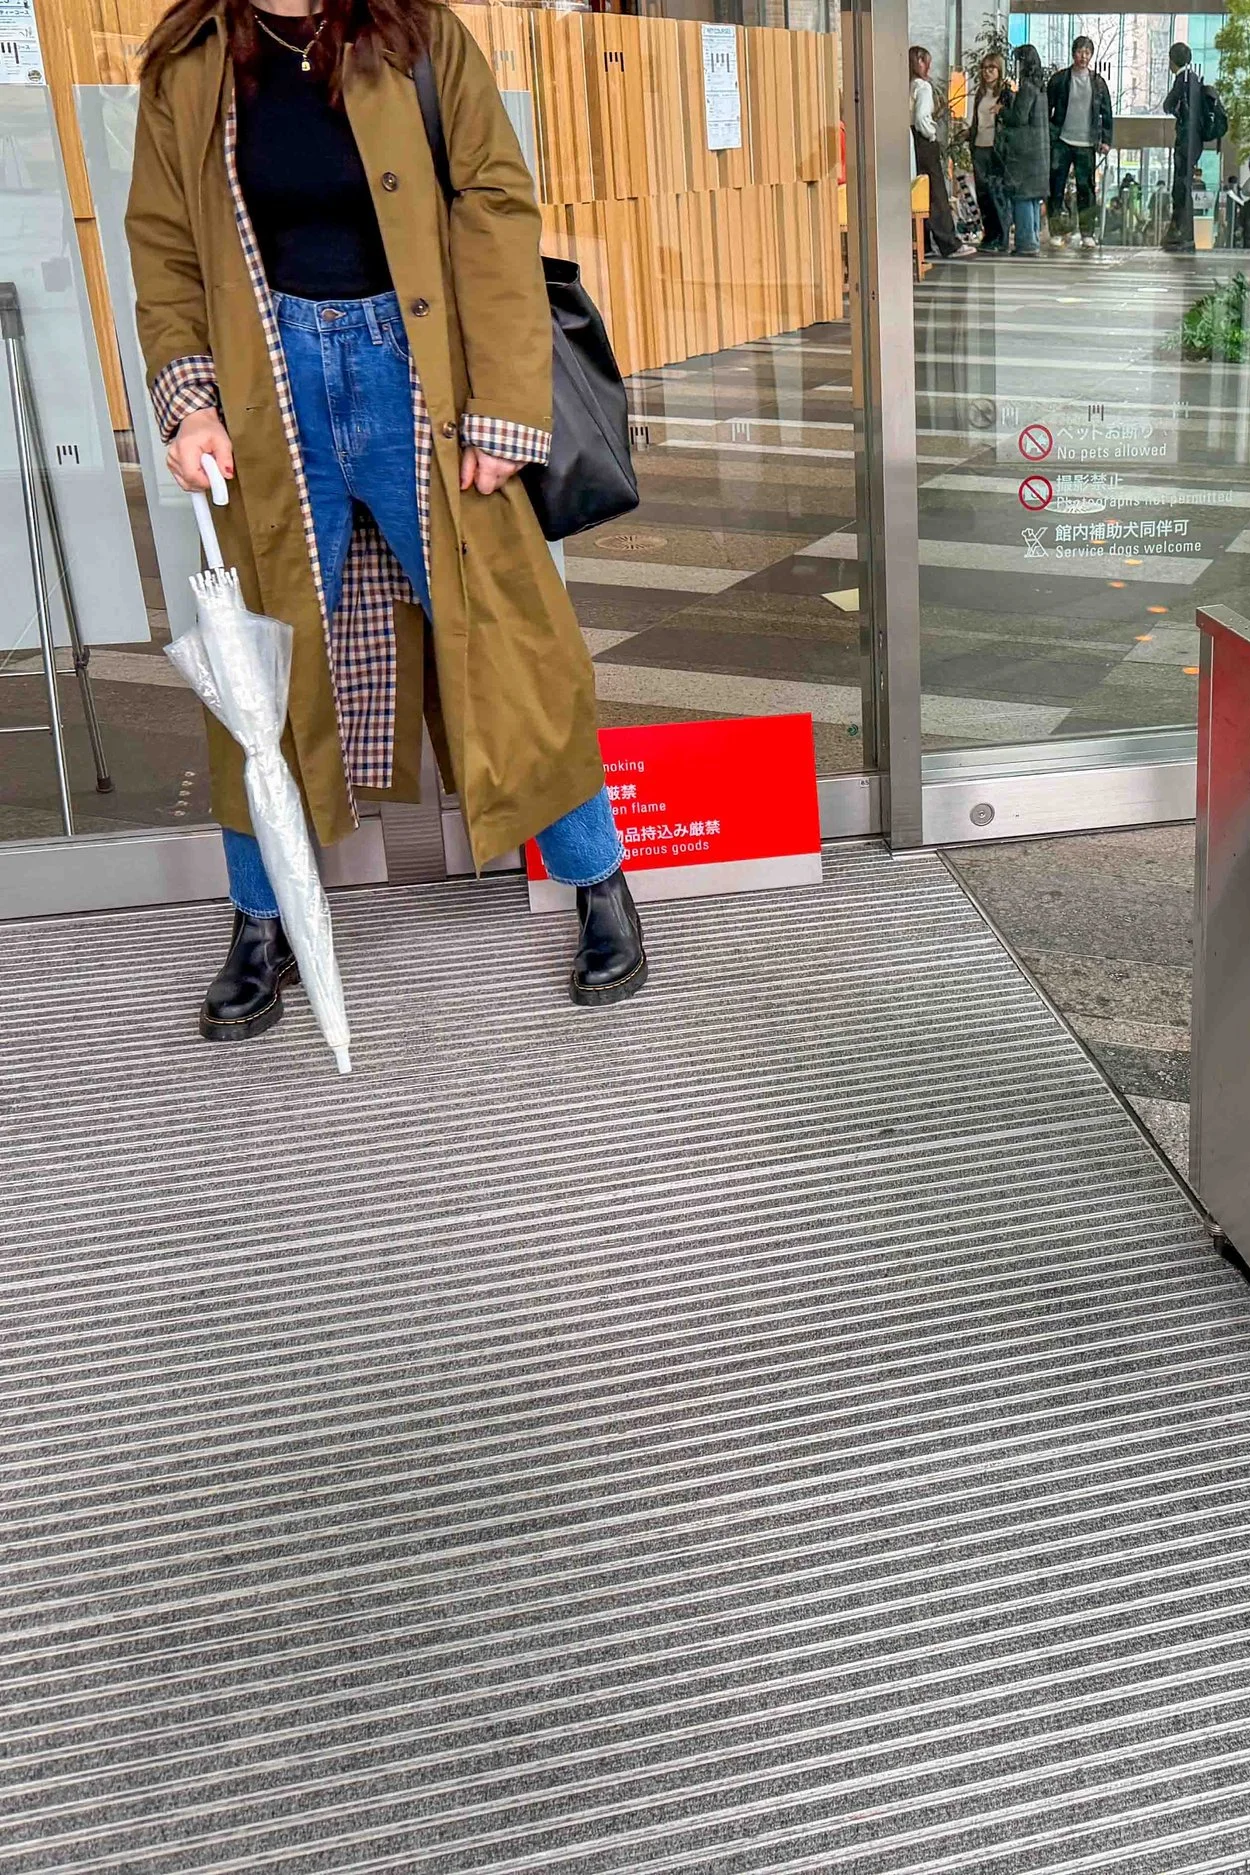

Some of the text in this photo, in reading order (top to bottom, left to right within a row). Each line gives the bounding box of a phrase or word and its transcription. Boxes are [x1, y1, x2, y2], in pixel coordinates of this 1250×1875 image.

[1057, 422, 1153, 441] ペットお断り
[1057, 442, 1167, 461] No pets allowed
[1056, 473, 1123, 492] 撮影禁止
[1056, 490, 1233, 510] Photographs not permitted
[1055, 519, 1189, 541] 館内補助犬同伴可
[1056, 541, 1201, 559] Service dogs welcome
[603, 759, 645, 772] moking
[607, 784, 637, 801] 厳禁
[612, 802, 667, 816] en flame
[618, 820, 720, 844] 品持込み厳禁
[624, 840, 709, 860] gerous goods
